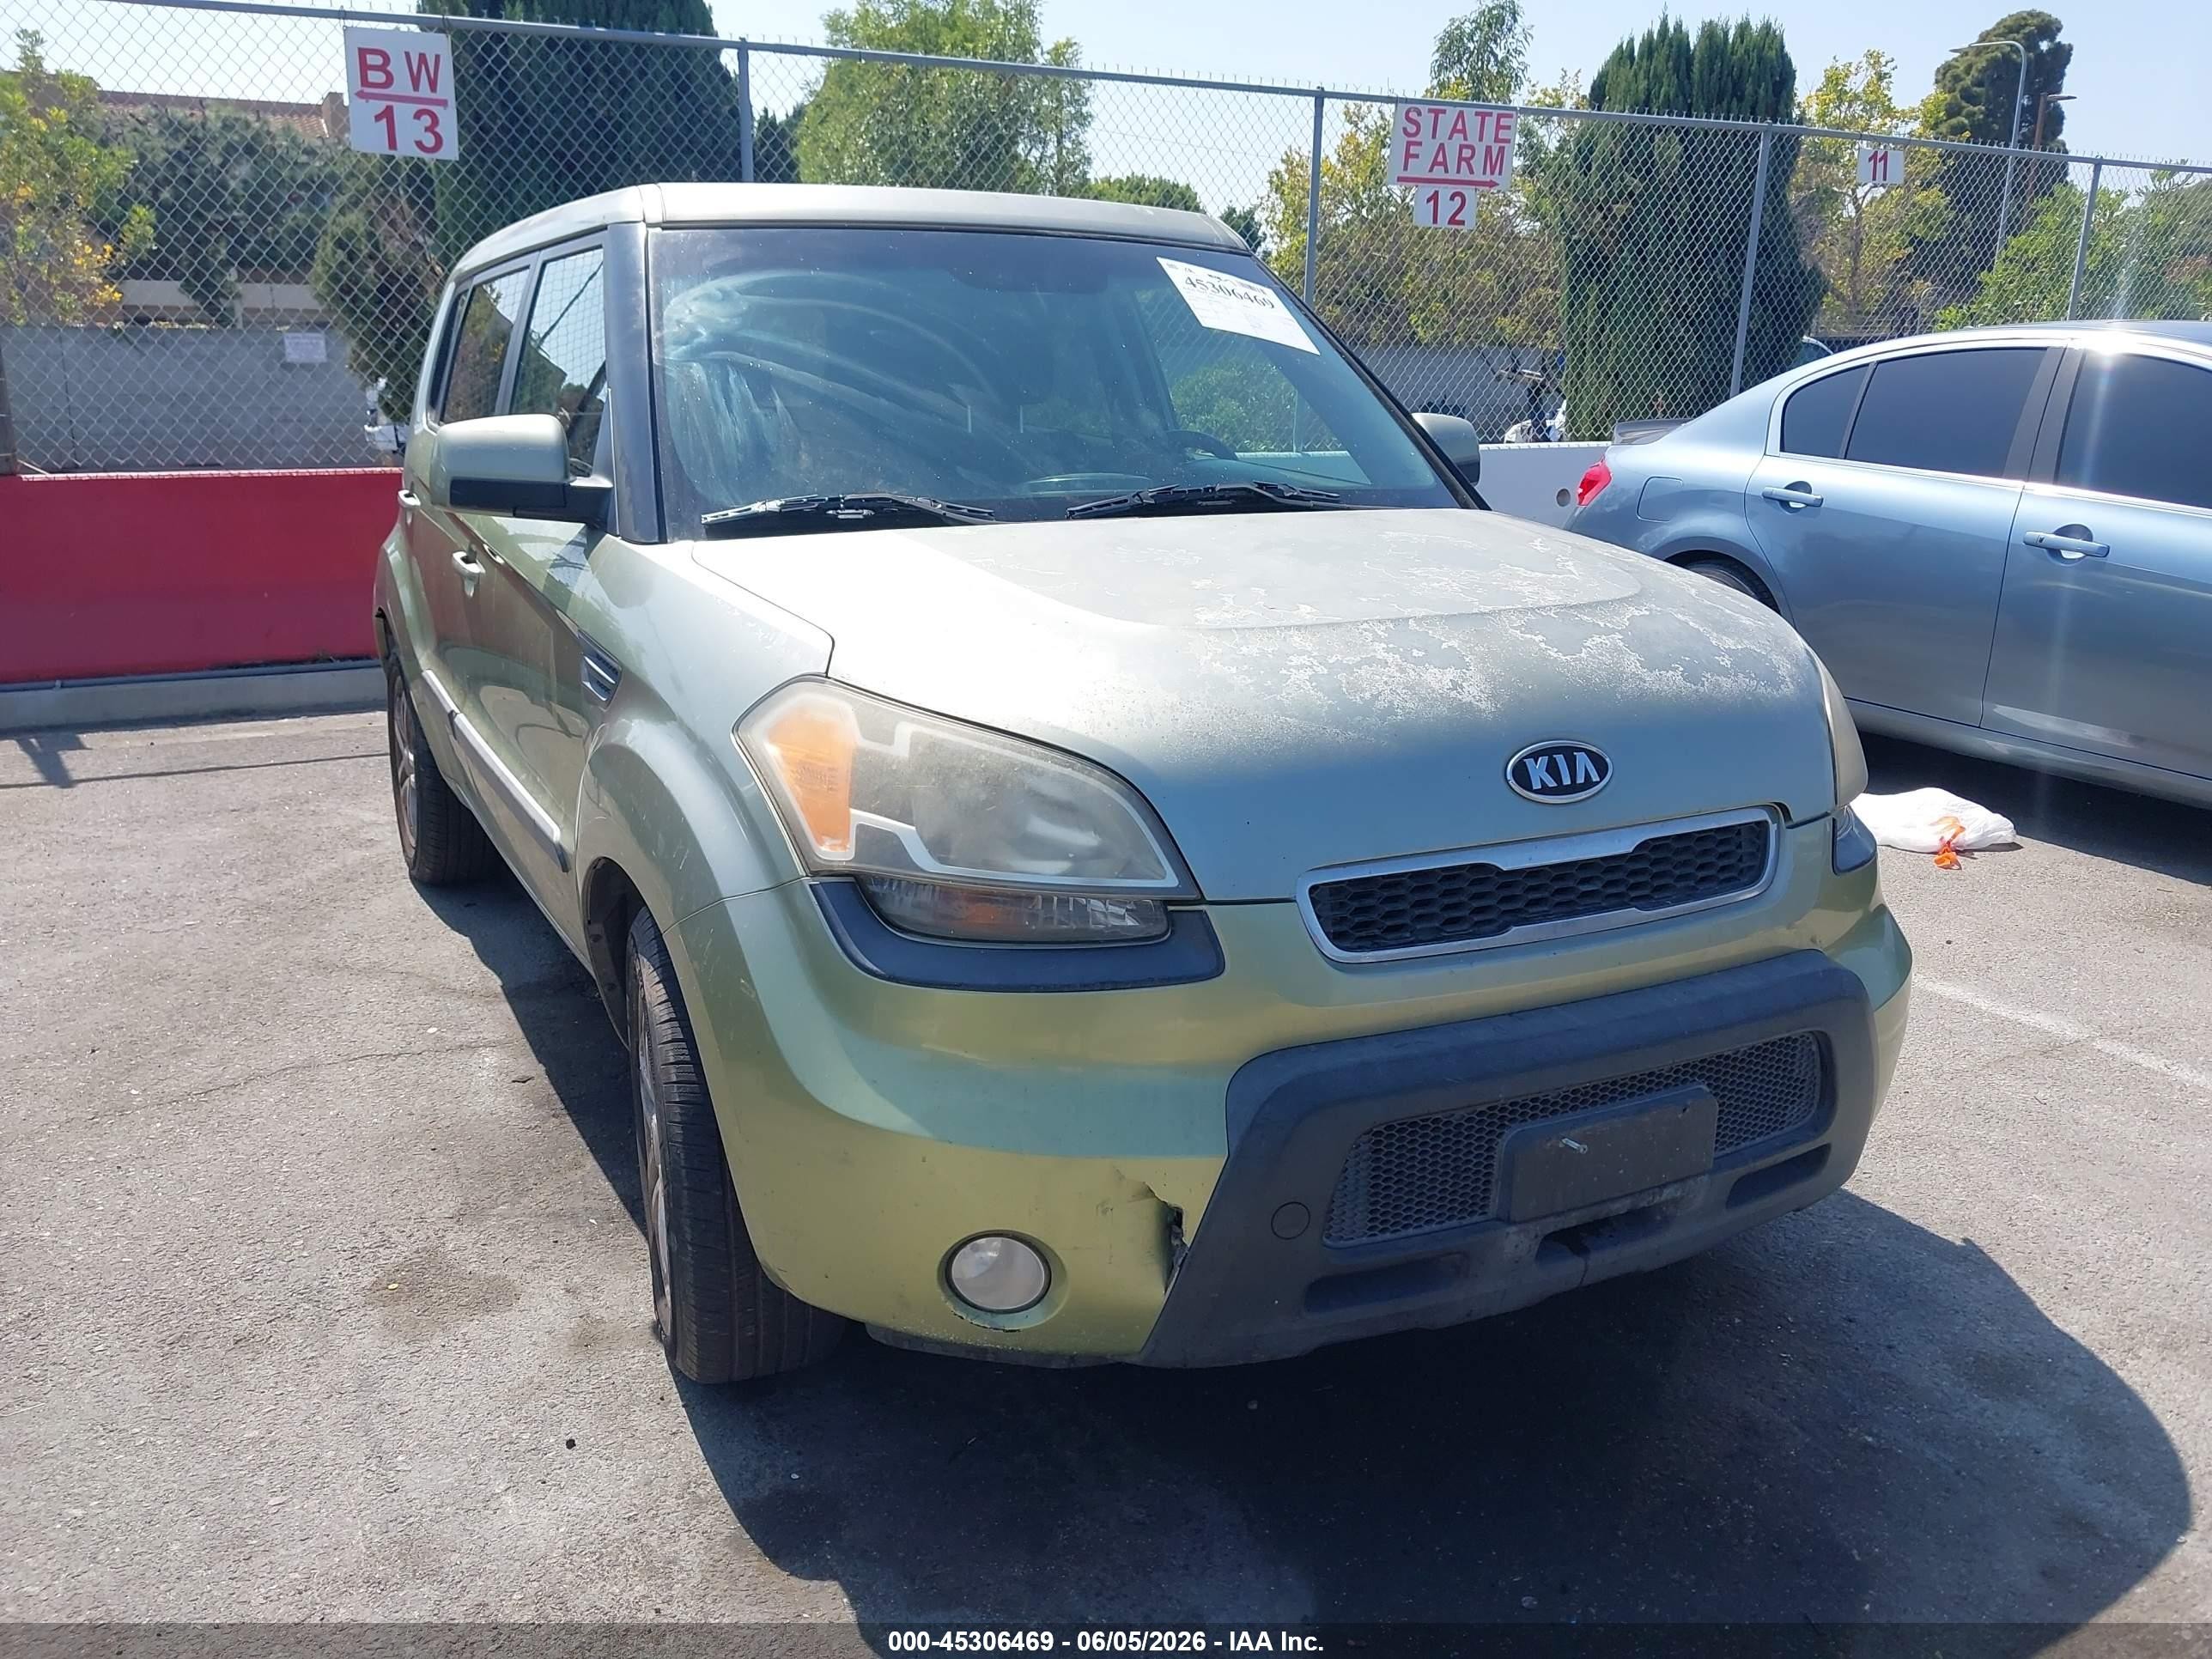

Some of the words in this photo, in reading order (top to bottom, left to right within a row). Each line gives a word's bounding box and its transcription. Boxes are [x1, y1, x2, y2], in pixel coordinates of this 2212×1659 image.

[374, 105, 443, 154] 13
[1402, 106, 1514, 144] STATE
[1402, 141, 1505, 176] FARM
[1869, 150, 1888, 181] 11
[1426, 190, 1467, 226] 12
[1184, 276, 1275, 309] 45306469
[1523, 751, 1601, 790] KIA
